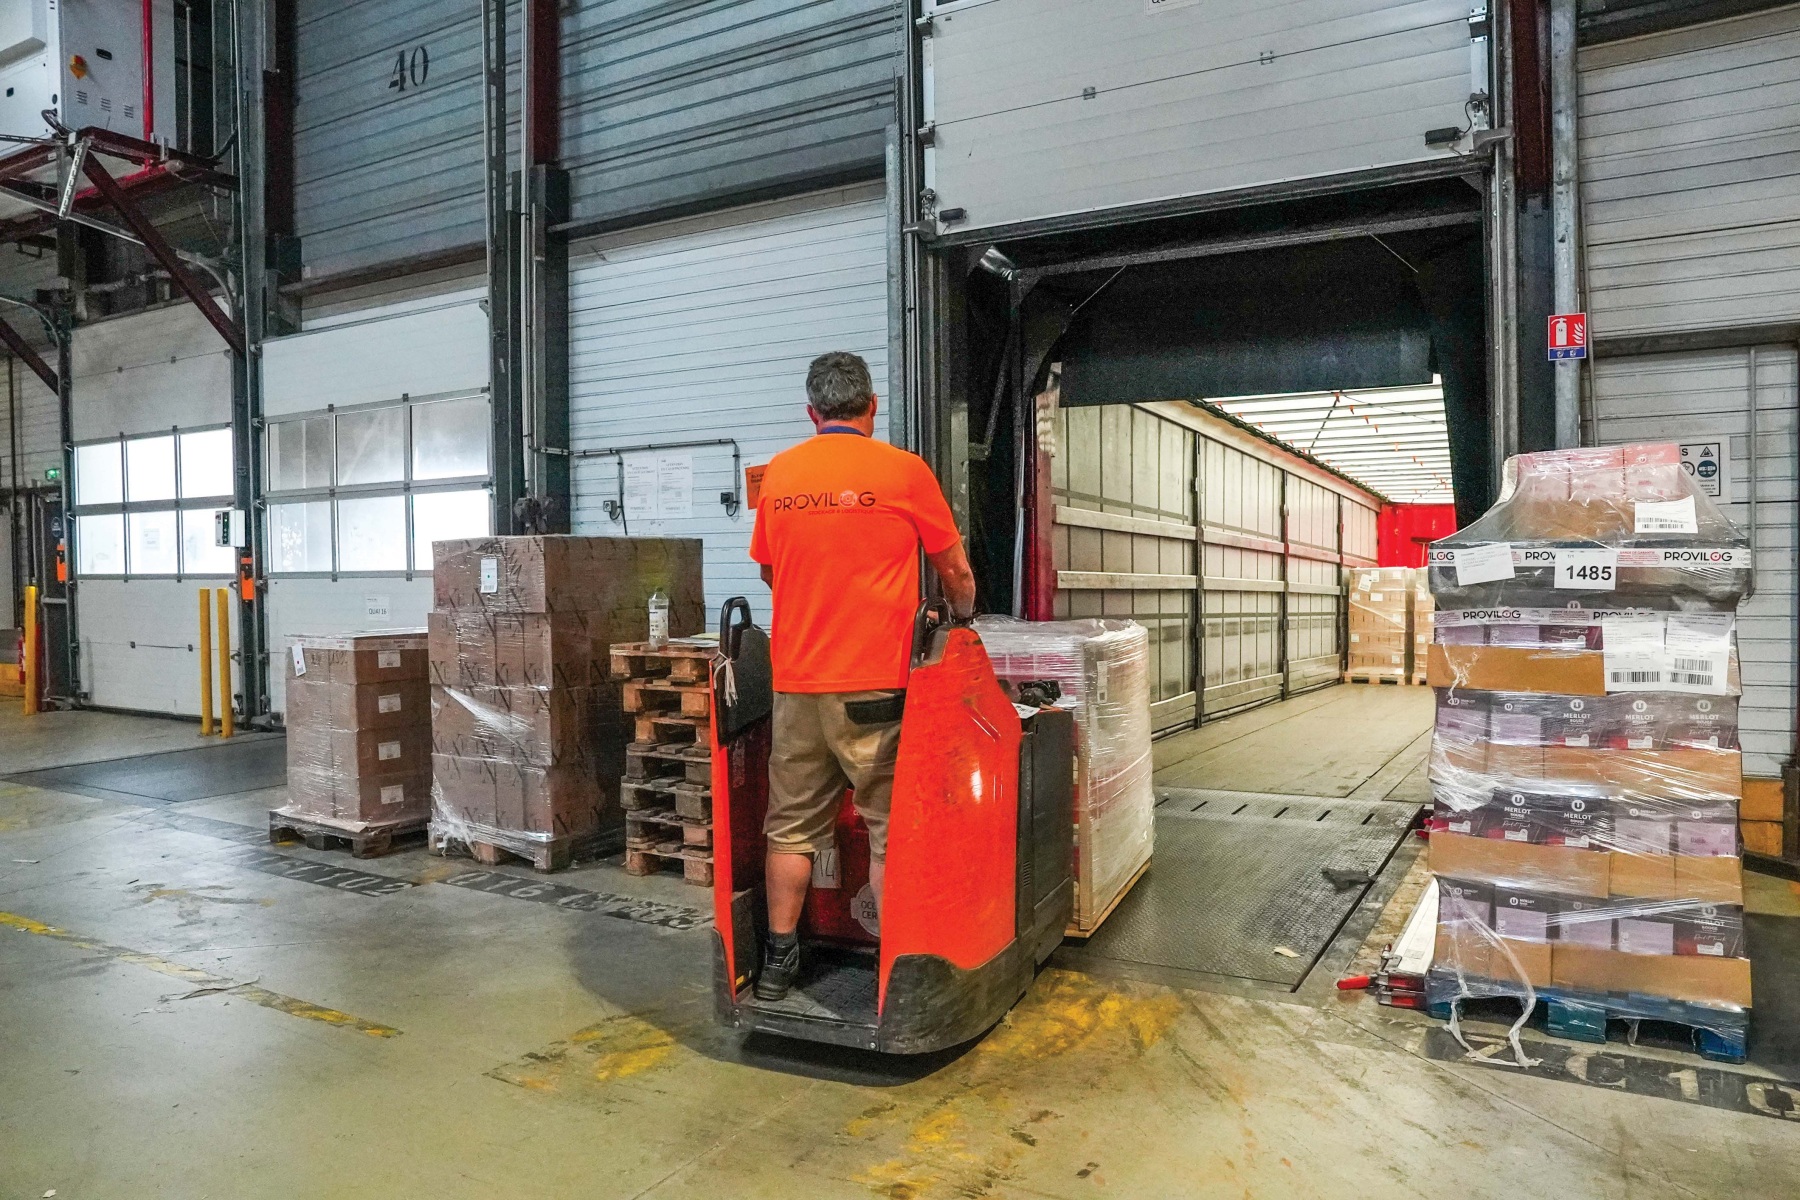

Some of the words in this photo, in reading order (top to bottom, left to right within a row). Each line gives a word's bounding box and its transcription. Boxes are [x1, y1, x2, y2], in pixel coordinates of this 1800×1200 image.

[389, 46, 429, 92] 40
[774, 490, 876, 514] PROVILOG
[1664, 551, 1733, 561] PROVILOG
[1566, 565, 1612, 581] 1485
[1462, 610, 1521, 620] PROVILOG
[1504, 806, 1531, 814] MERLOT
[1563, 812, 1592, 820] MERLOT
